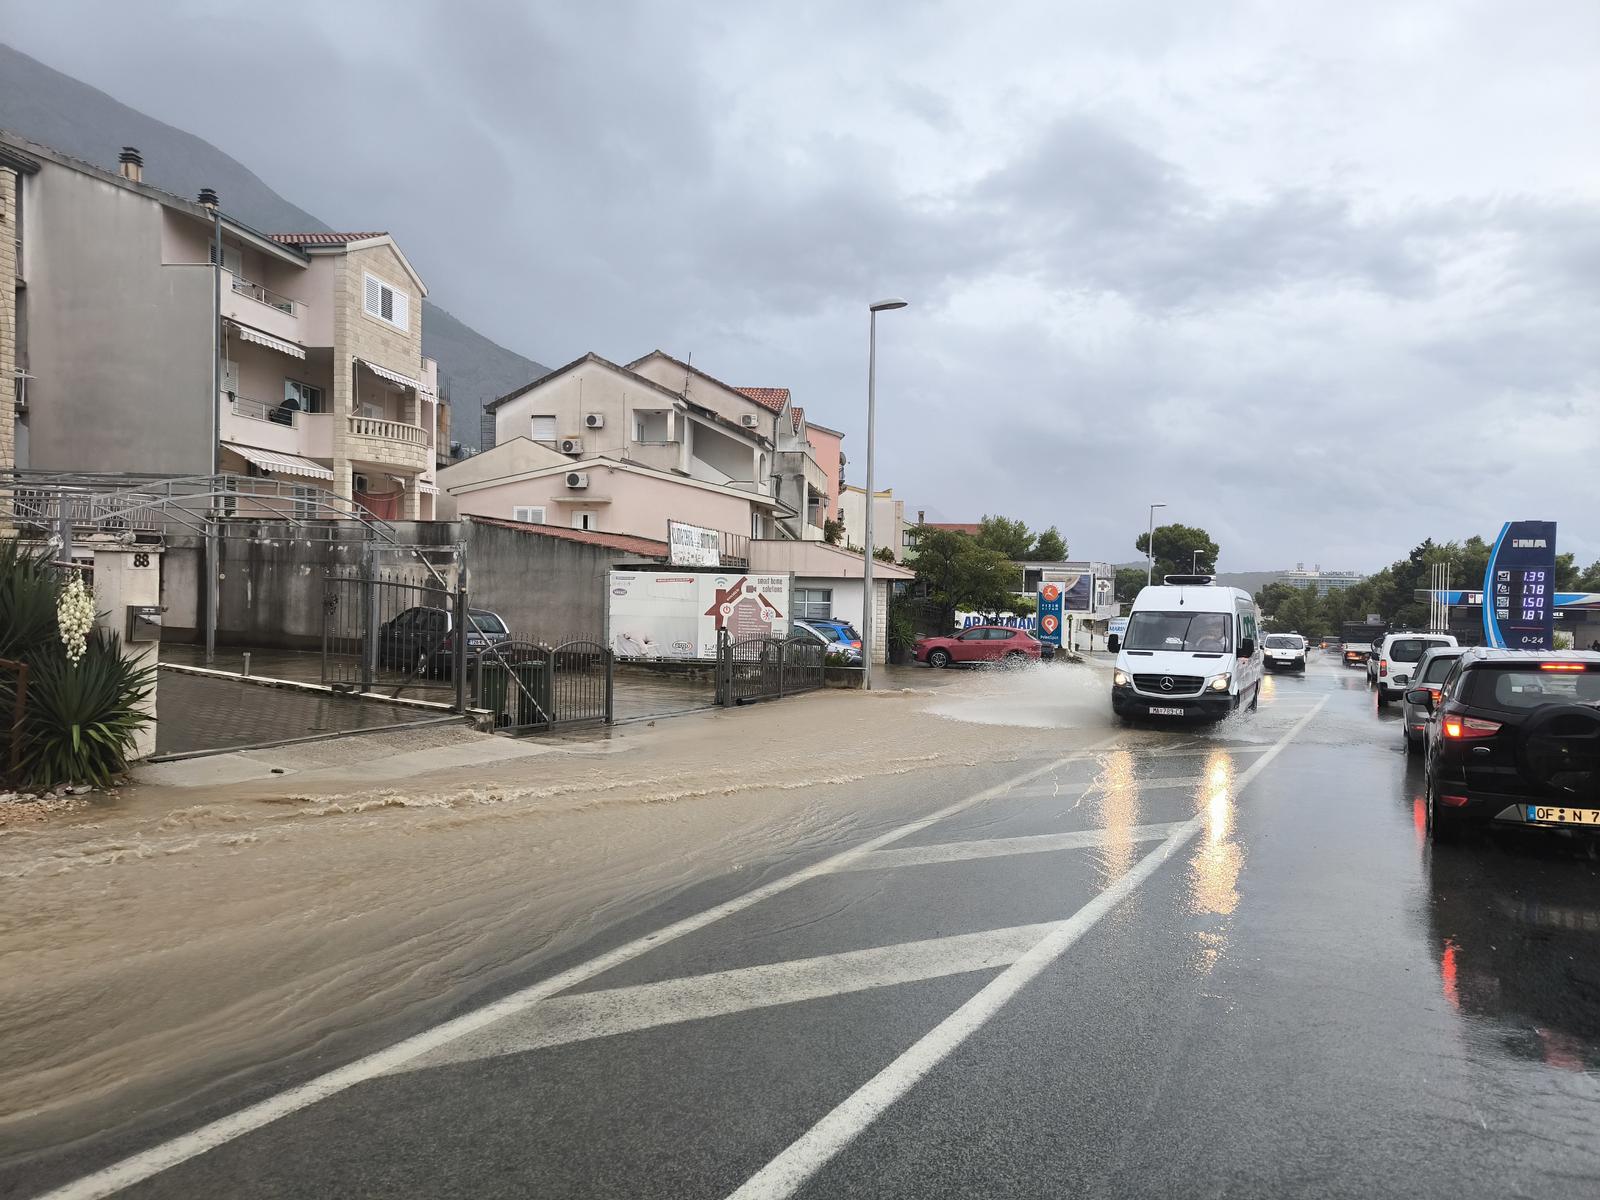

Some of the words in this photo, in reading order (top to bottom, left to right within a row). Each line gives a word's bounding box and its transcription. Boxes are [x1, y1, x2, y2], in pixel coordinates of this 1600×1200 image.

[133, 553, 150, 567] 88
[1523, 571, 1545, 582] 1.39
[1522, 584, 1545, 595] 1.78
[1522, 597, 1545, 608] 1.50
[1521, 610, 1544, 620] 1.87
[1521, 636, 1544, 644] 0-24
[1536, 807, 1554, 819] OF
[1572, 810, 1582, 821] N
